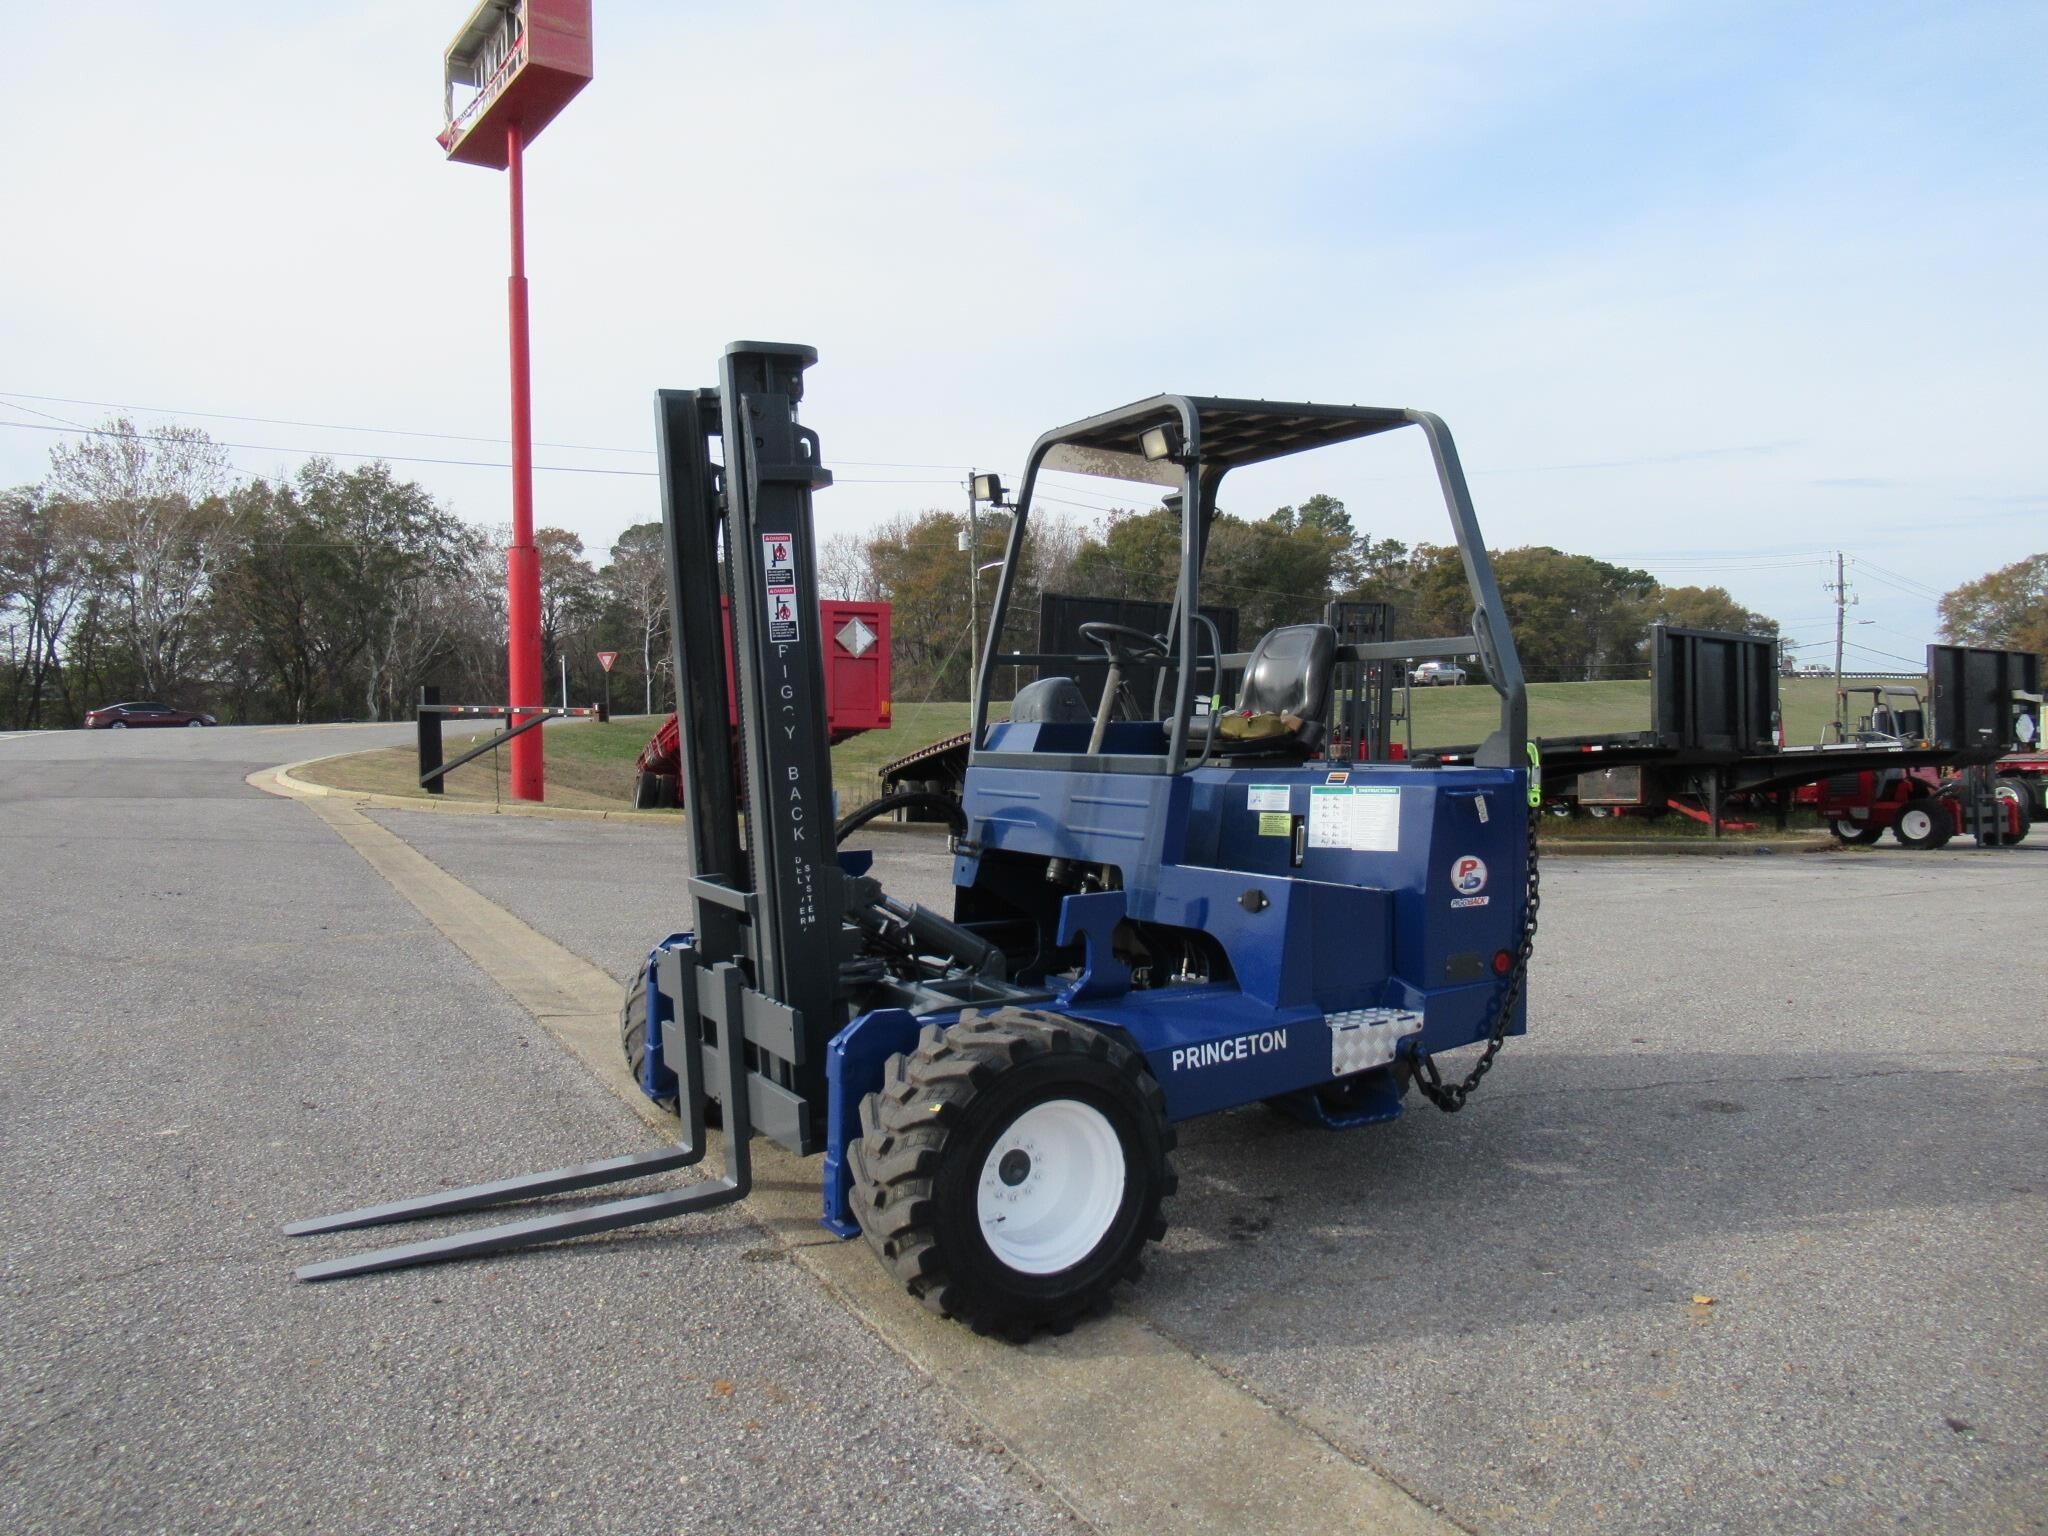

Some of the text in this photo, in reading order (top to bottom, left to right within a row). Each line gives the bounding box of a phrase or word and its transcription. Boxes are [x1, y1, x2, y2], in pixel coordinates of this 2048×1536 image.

[788, 766, 806, 842] BACK
[804, 864, 816, 924] SYSTEM
[1172, 1028, 1287, 1071] PRINCETON
